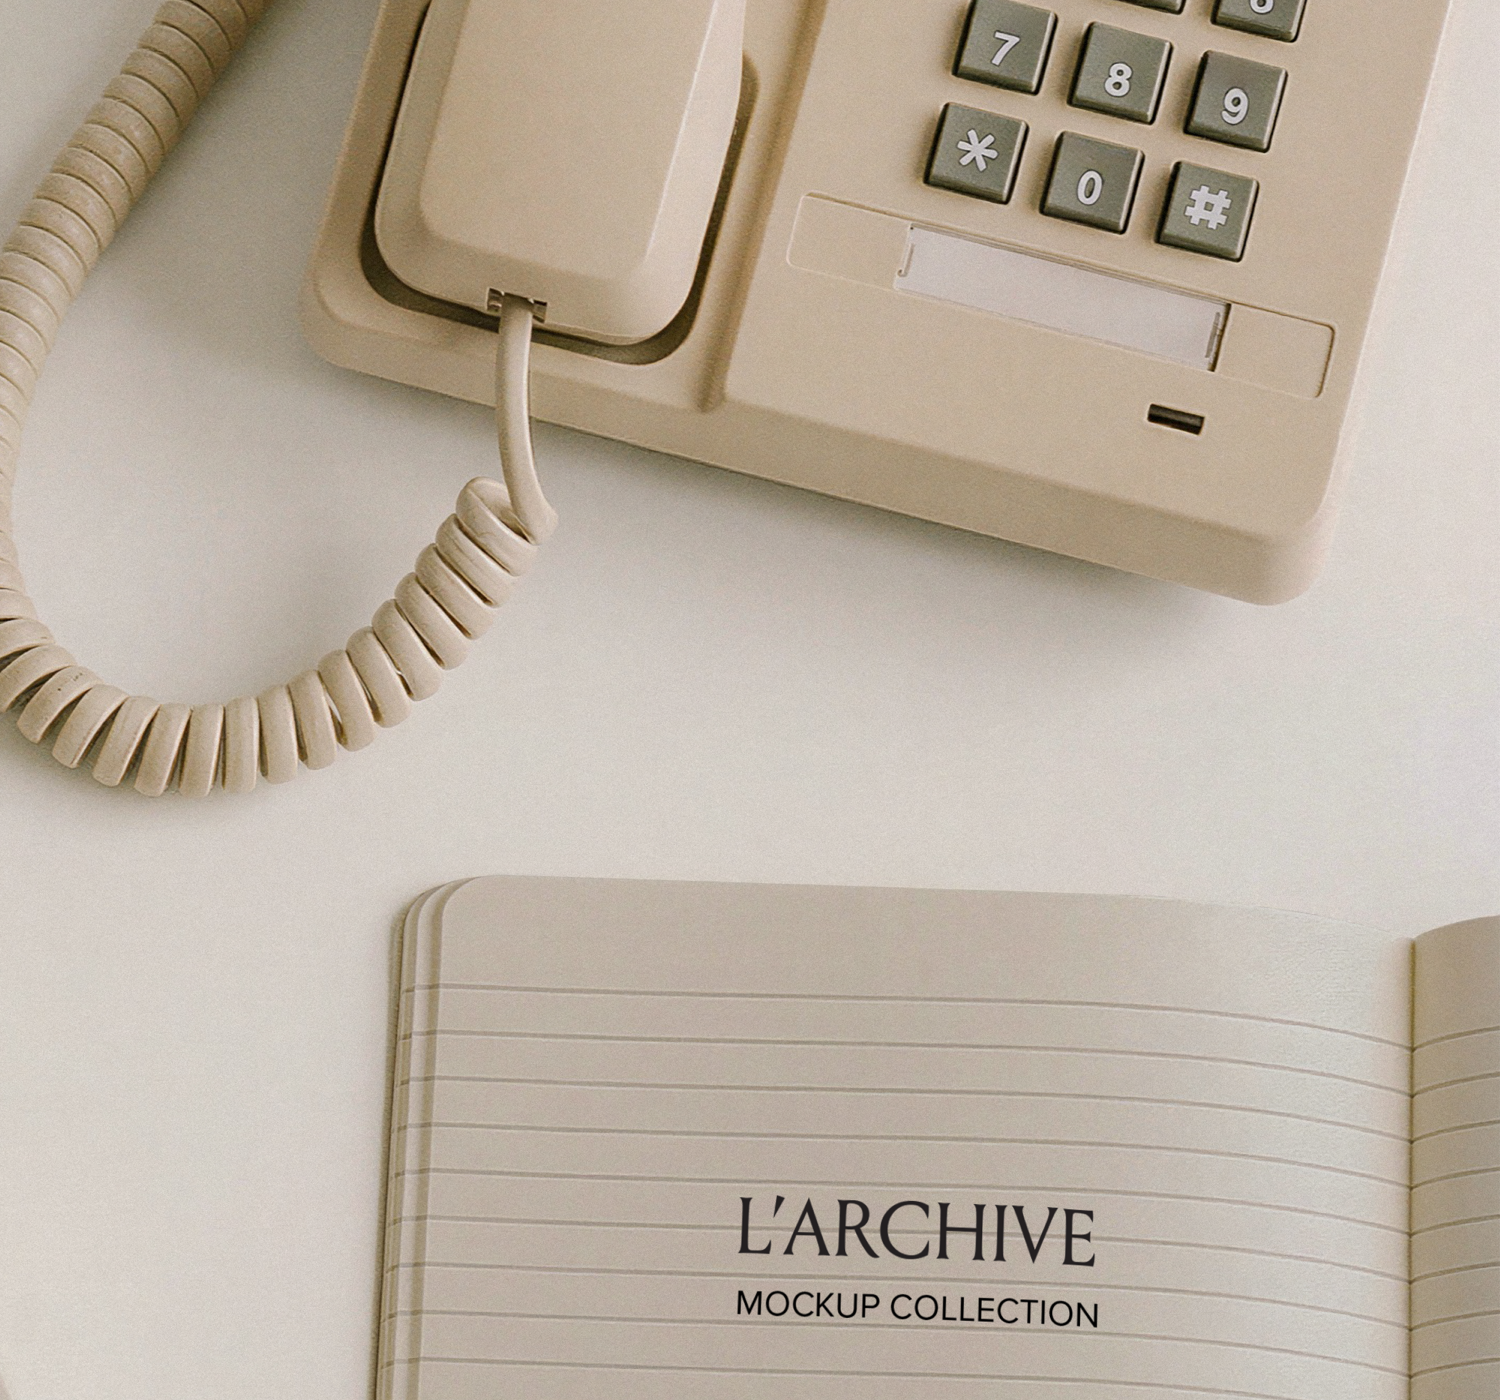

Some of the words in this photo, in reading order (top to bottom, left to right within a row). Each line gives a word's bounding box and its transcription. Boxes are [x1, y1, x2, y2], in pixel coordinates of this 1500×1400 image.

[991, 31, 1020, 66] 7
[1104, 63, 1132, 97] 8
[1221, 88, 1248, 124] 9
[1077, 170, 1102, 205] 0
[1184, 185, 1232, 230] #
[737, 1290, 880, 1319] MOCKUP
[890, 1293, 1098, 1328] COLLECTION
